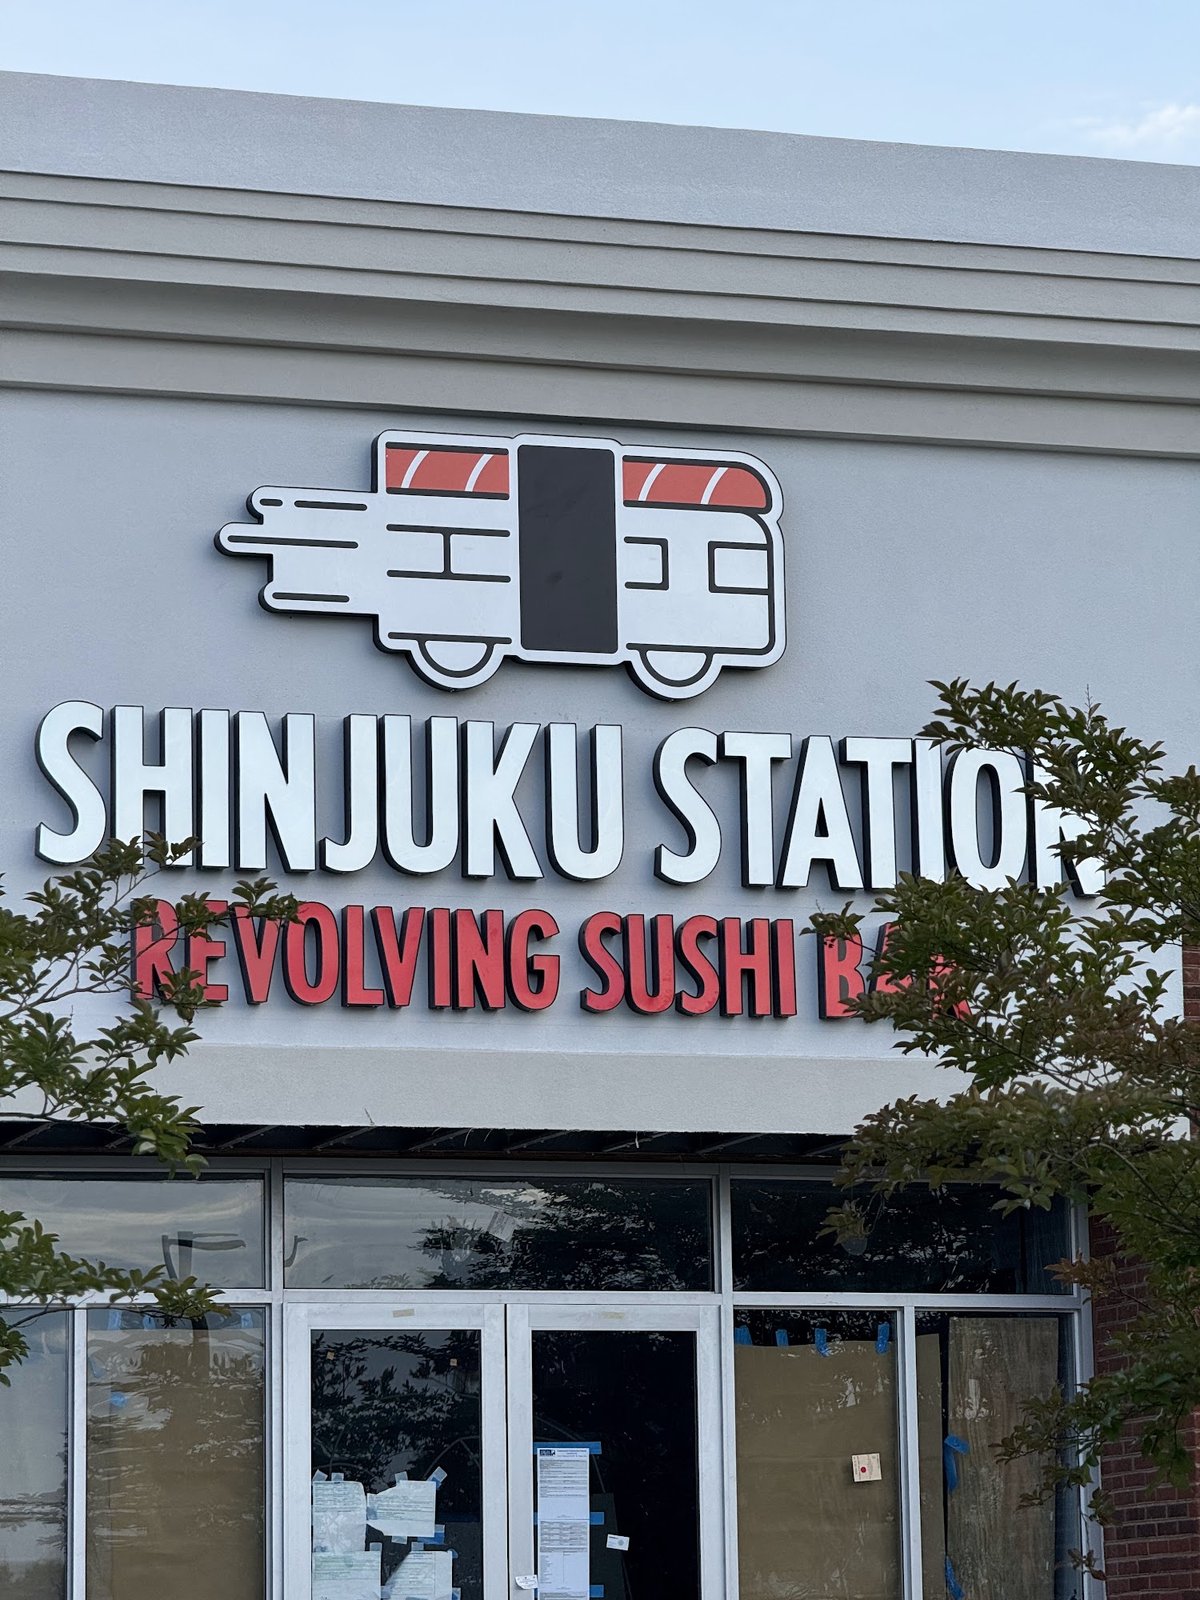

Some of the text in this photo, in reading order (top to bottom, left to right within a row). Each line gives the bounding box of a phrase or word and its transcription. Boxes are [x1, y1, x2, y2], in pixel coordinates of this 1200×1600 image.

[35, 700, 625, 881] SHINJUKU
[130, 898, 561, 1012] REVOLVING
[578, 911, 798, 1018] SUSHI
